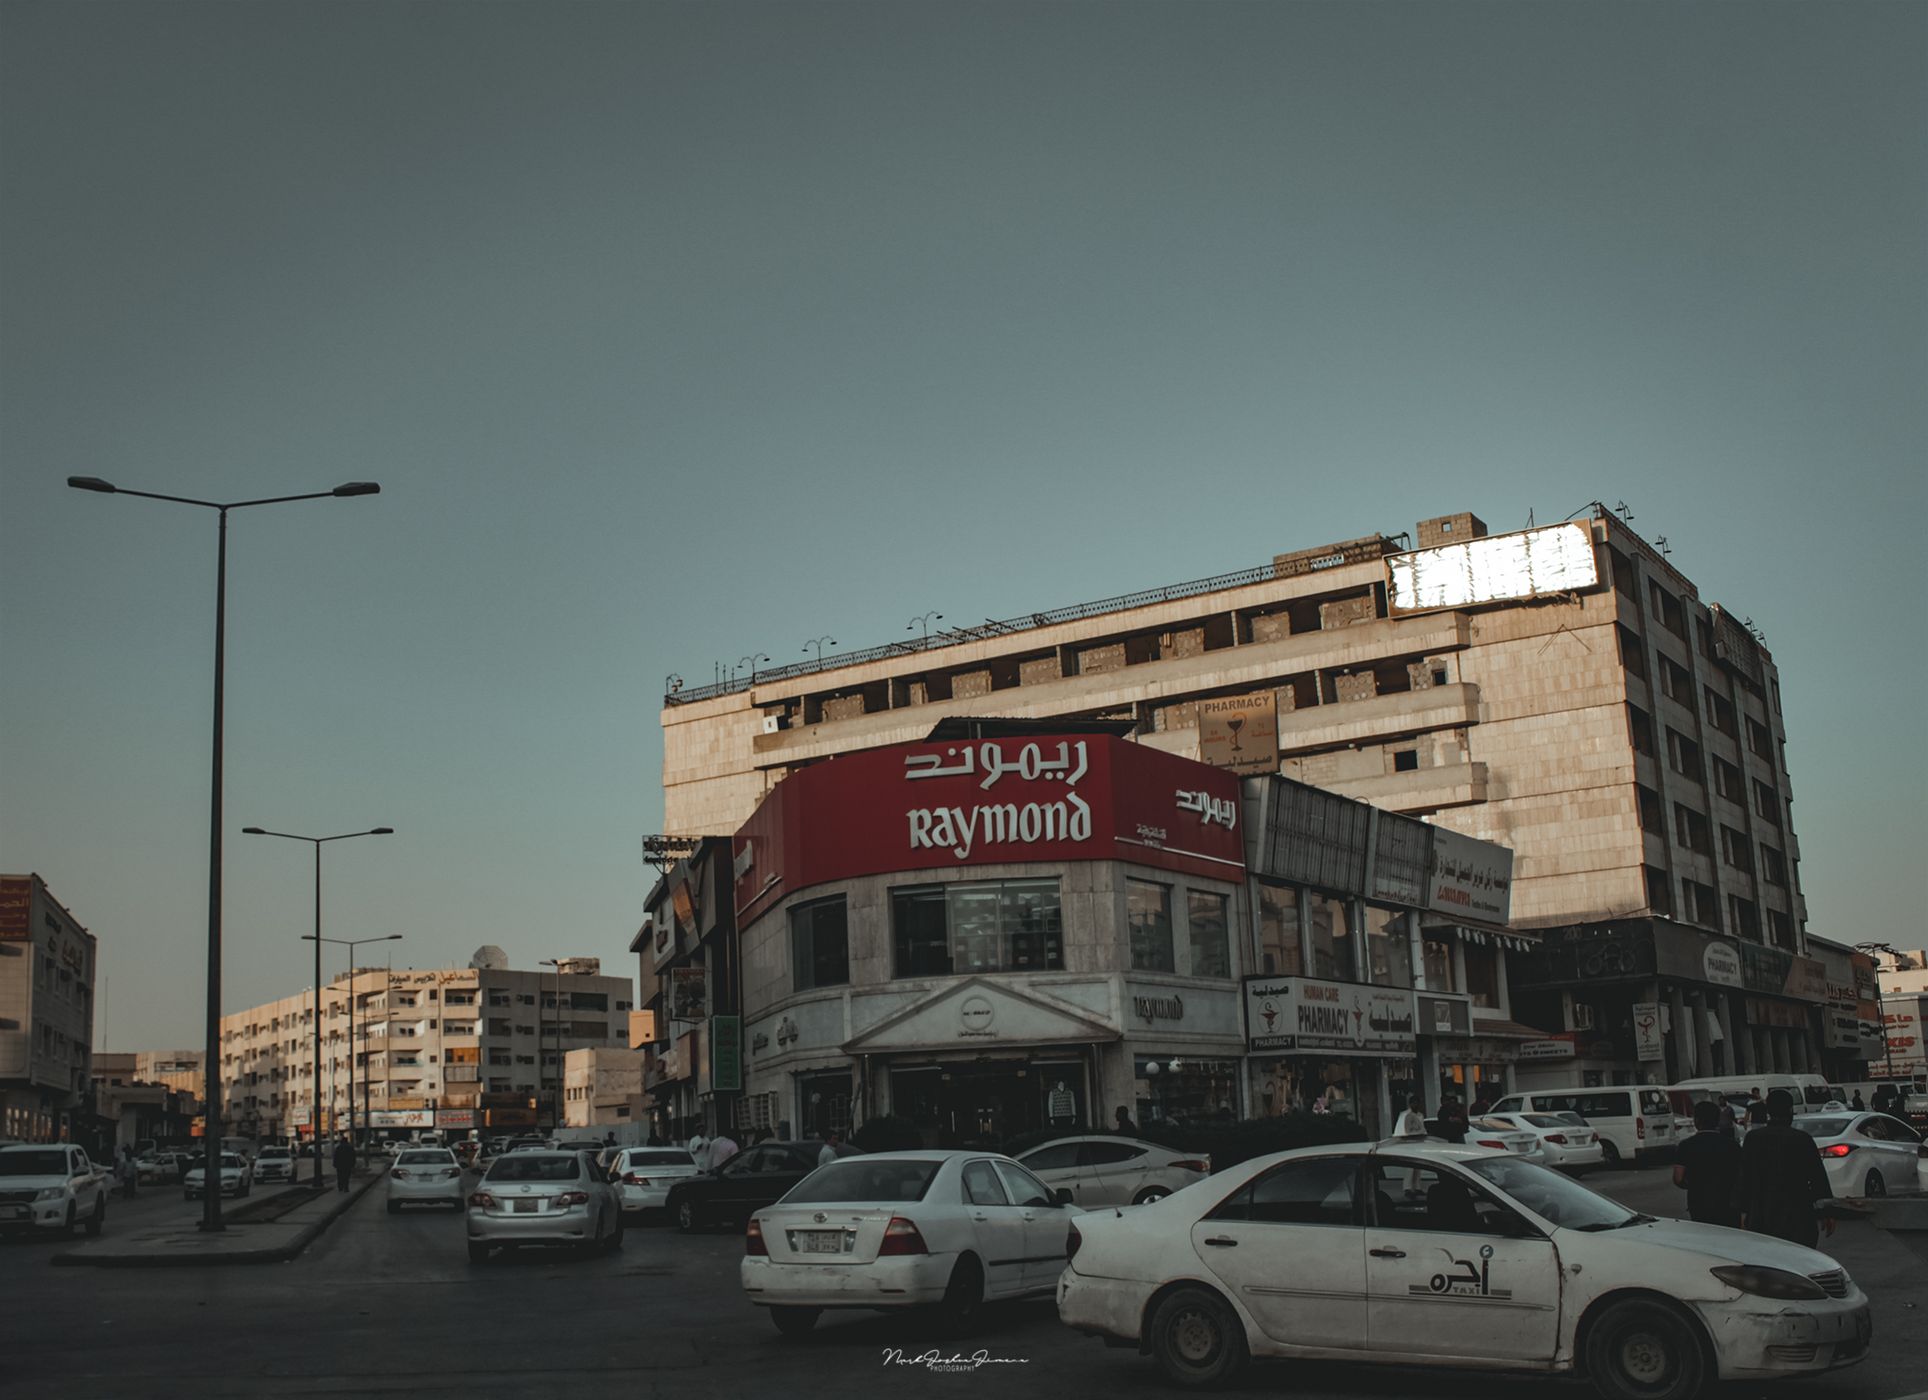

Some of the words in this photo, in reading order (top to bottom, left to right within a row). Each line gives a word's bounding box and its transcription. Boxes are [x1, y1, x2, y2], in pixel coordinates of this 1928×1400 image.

[1204, 696, 1270, 713] PHARMACY
[904, 740, 1088, 791] ريموند
[1175, 789, 1237, 831] ريموند
[1252, 984, 1289, 999] صيدلية
[1303, 984, 1324, 1000] HUMAN
[1325, 987, 1340, 1002] CARE
[1298, 1004, 1349, 1035] PHARMACY
[1369, 1001, 1413, 1040] صيدلية
[1254, 1037, 1292, 1049] PHARMACY
[1453, 1286, 1480, 1295] TAXI
